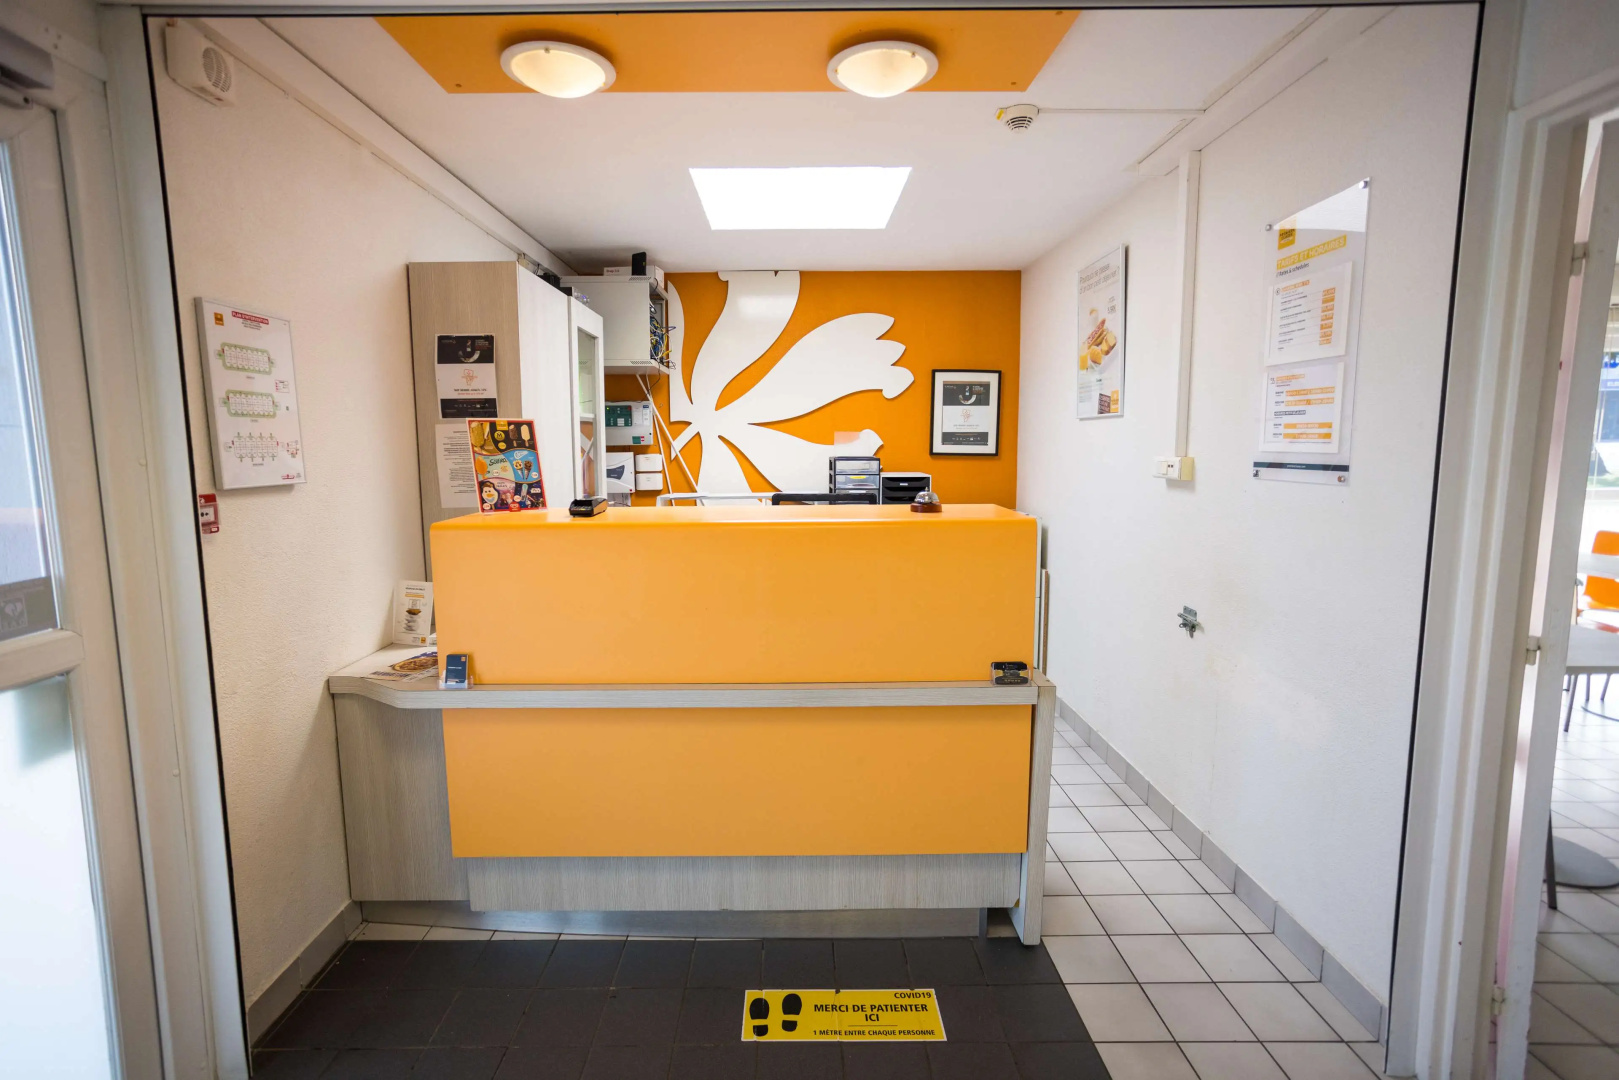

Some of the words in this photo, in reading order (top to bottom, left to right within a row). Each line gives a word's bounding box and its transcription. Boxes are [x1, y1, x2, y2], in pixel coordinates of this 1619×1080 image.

[814, 1004, 849, 1012] MERCI
[852, 1004, 868, 1012] DE
[870, 1004, 928, 1012] PATIENTER
[864, 1014, 880, 1022] ICI
